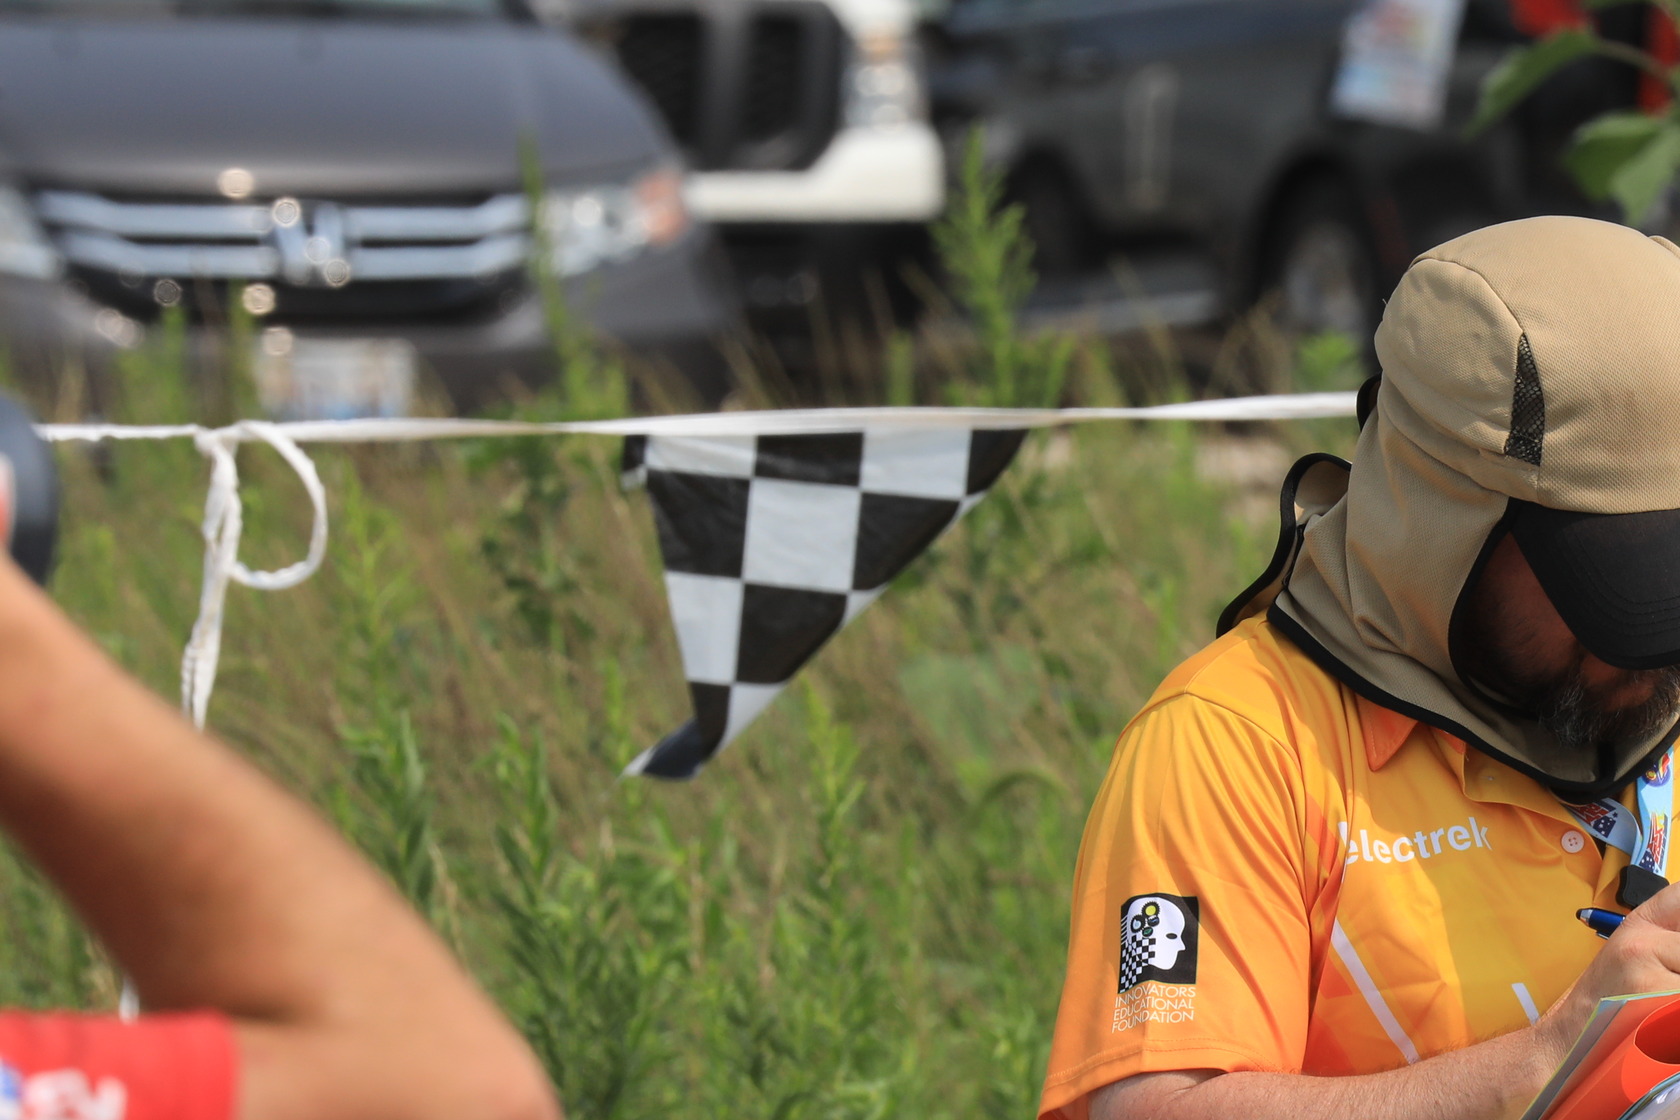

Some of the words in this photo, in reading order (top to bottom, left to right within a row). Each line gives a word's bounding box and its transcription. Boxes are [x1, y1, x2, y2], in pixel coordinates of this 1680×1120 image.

[1115, 983, 1196, 1008] INNOVATORS
[1113, 996, 1195, 1021] EDUCATIONAL
[1111, 1010, 1195, 1034] FOUNDATION
